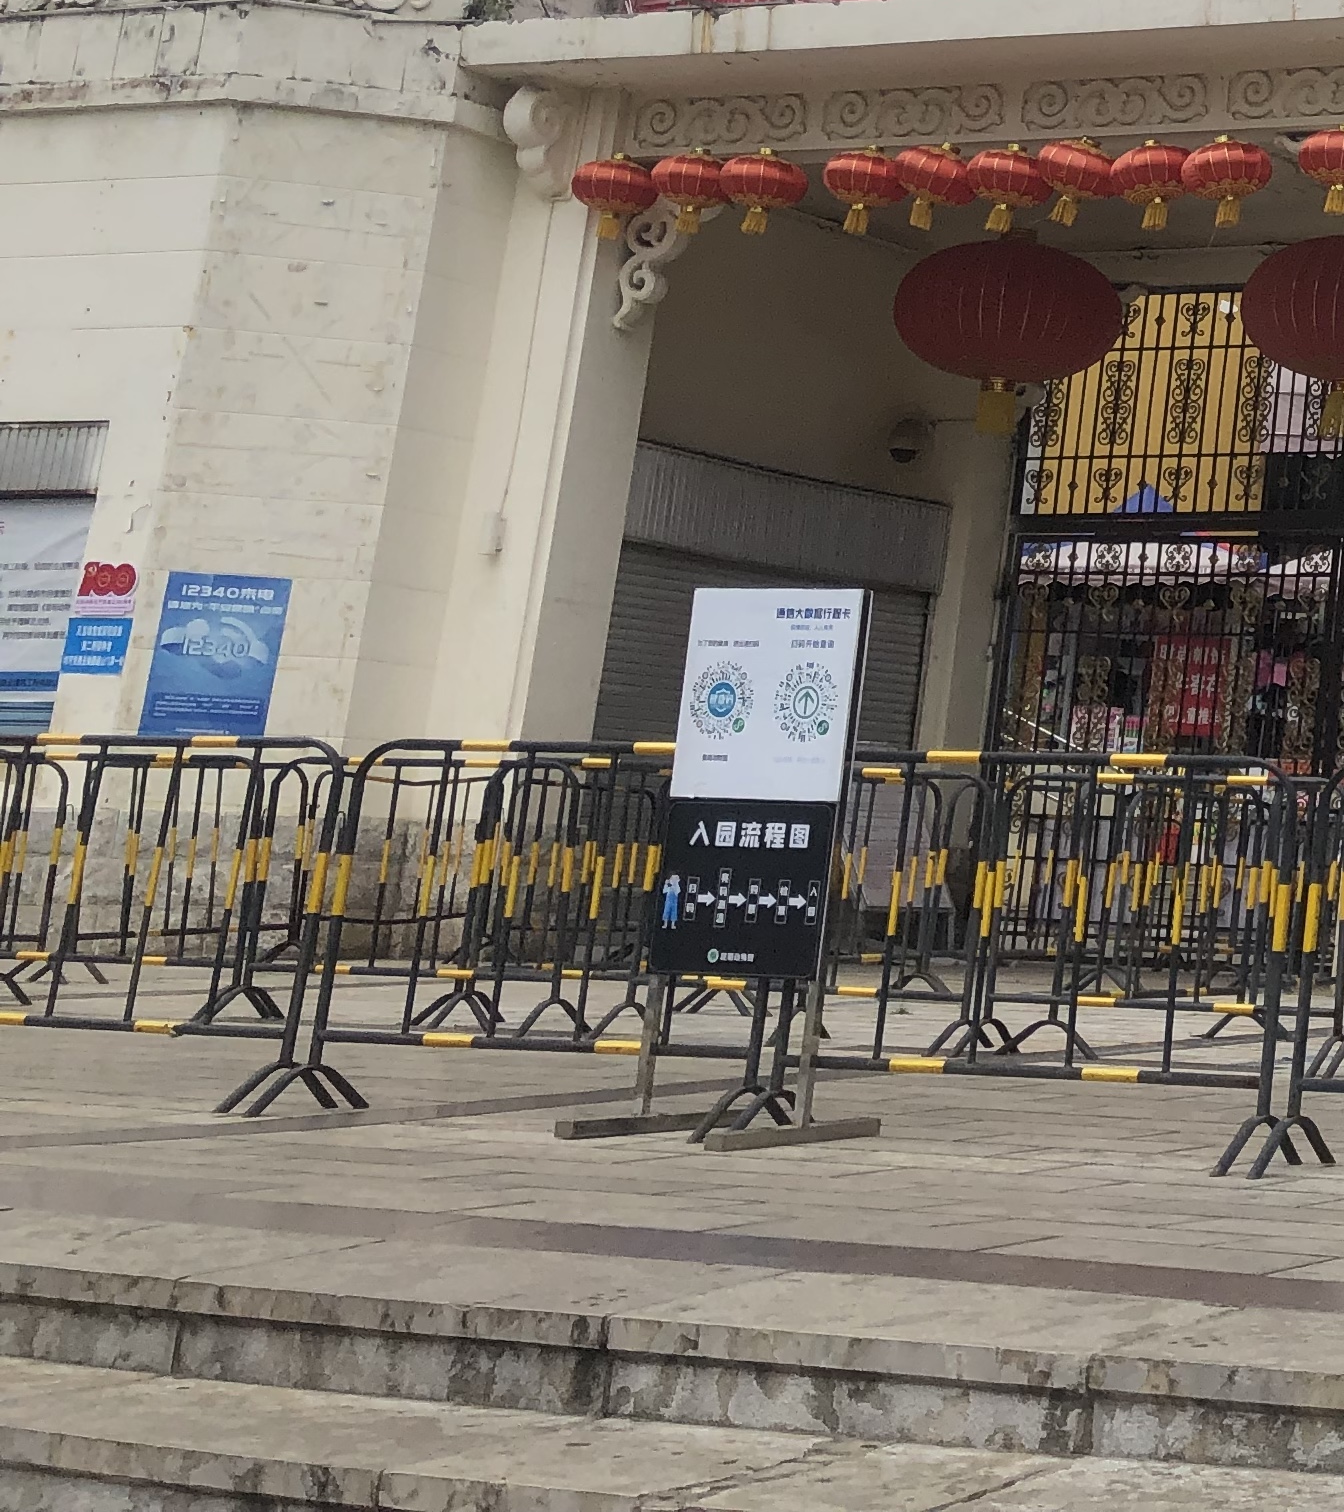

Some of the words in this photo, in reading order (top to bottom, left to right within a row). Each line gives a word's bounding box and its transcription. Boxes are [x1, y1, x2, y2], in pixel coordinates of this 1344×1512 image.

[181, 584, 275, 601] 12340来电
[688, 820, 811, 849] 入园流程图
